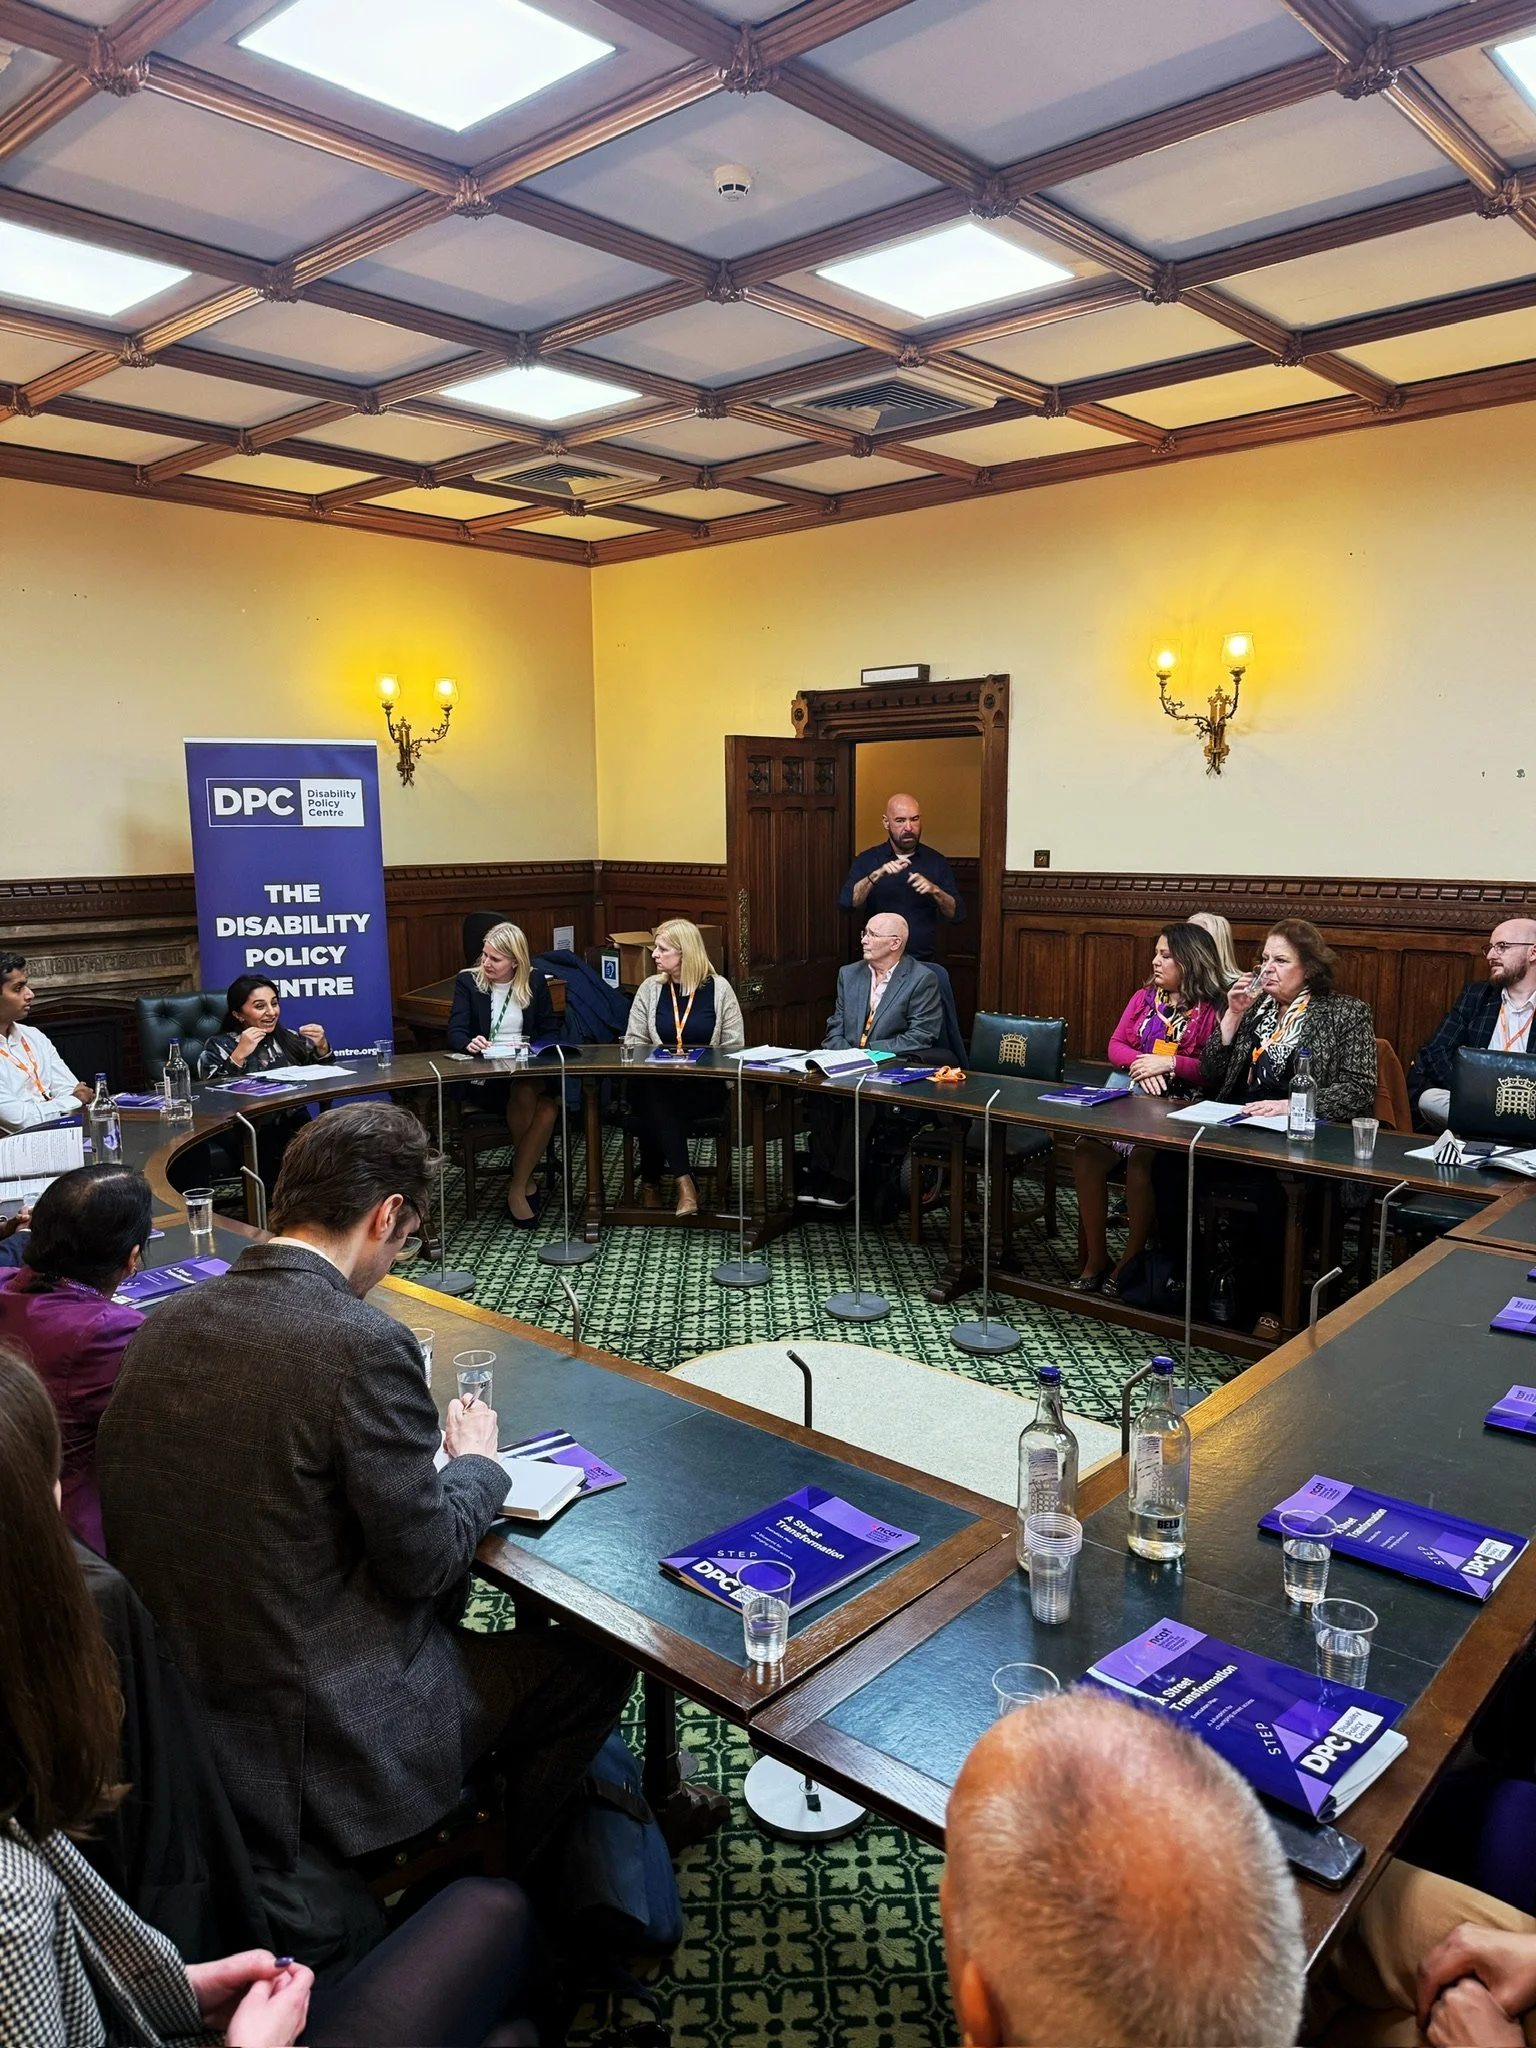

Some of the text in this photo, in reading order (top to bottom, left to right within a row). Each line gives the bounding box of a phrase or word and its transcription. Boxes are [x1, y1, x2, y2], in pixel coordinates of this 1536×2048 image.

[213, 787, 296, 816] DPC
[307, 789, 357, 799] Disability
[308, 799, 340, 809] Policy
[308, 808, 344, 817] Centre
[264, 884, 321, 904] THE
[216, 913, 371, 937] DISABILITY
[245, 945, 347, 968] POLICY
[783, 1515, 823, 1539] A Street
[1157, 1518, 1180, 1530] BELU
[776, 1519, 845, 1560] Transformation
[717, 1549, 759, 1558] STEP
[691, 1560, 740, 1592] DPC
[1461, 1555, 1496, 1577] DPC
[1149, 1627, 1173, 1645] ncat
[1154, 1676, 1196, 1706] A Street
[1168, 1664, 1239, 1712] Transformation
[1337, 1711, 1362, 1733] Disability
[1345, 1721, 1364, 1737] Policy
[1354, 1723, 1373, 1739] Centre
[1255, 1722, 1282, 1756] STEP
[1300, 1735, 1352, 1775] DPC
